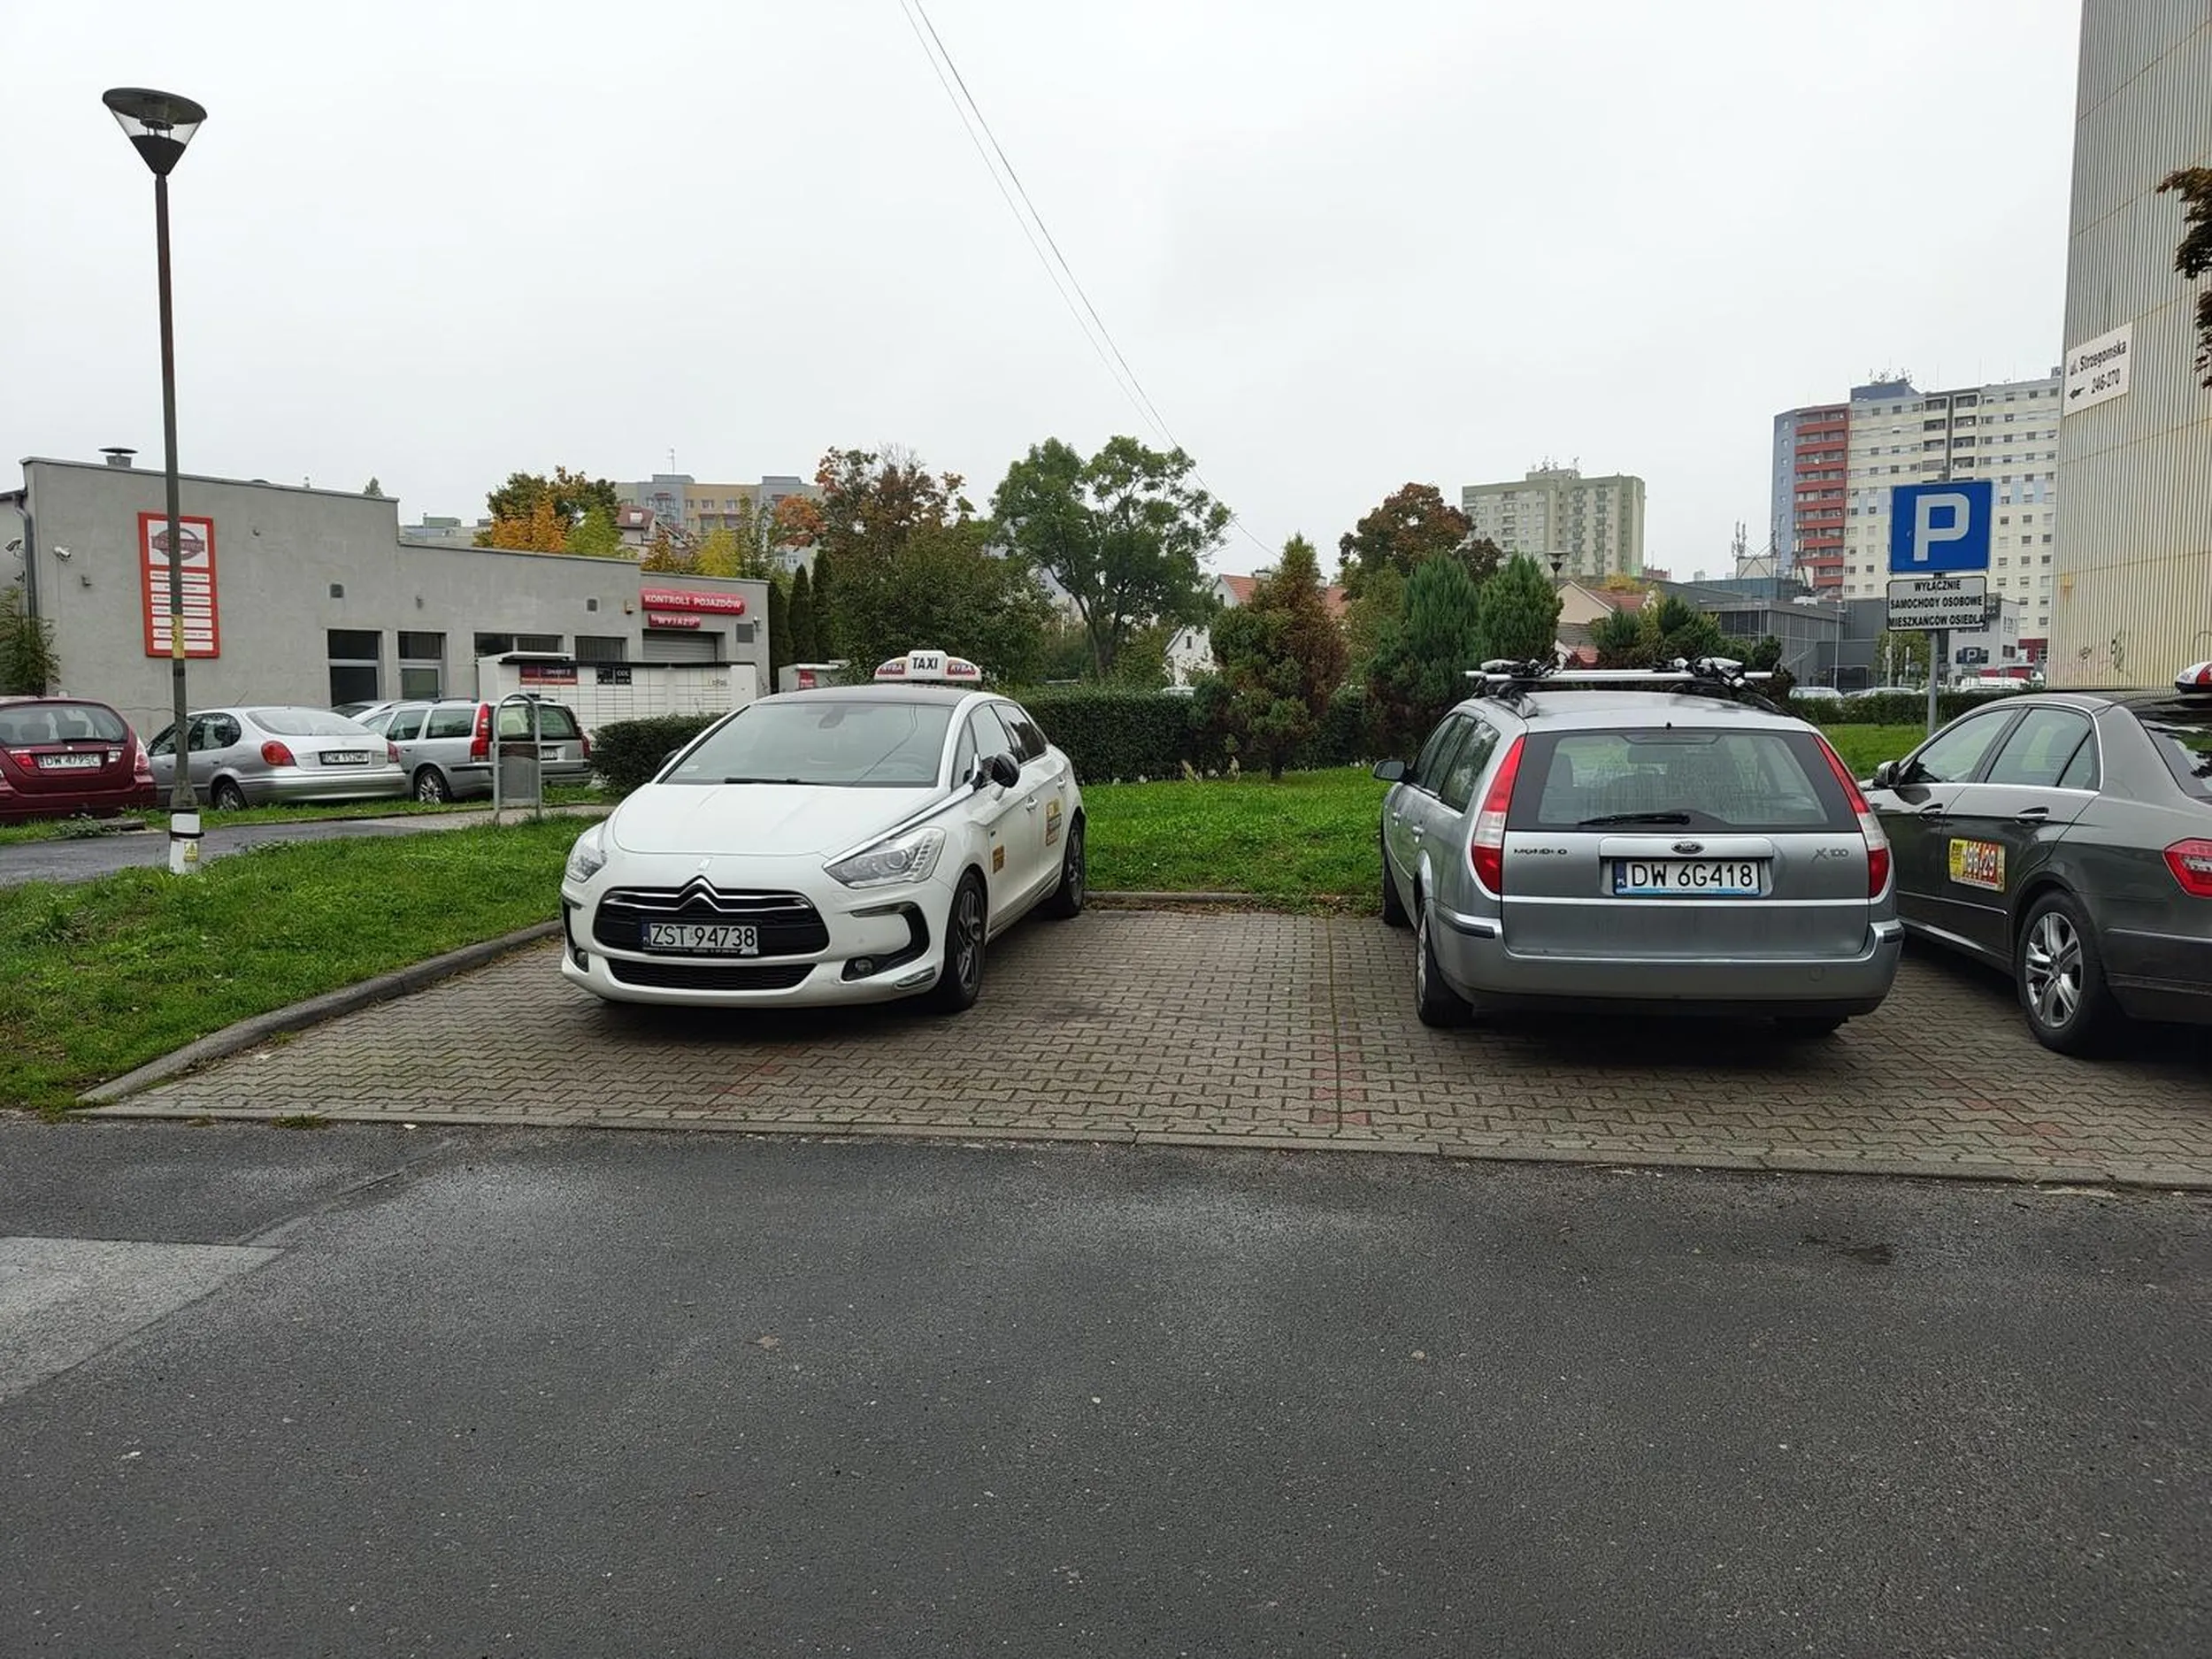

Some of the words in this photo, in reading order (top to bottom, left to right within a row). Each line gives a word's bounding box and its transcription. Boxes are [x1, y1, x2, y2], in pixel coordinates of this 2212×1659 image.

[1913, 492, 1970, 562] P
[1890, 597, 1940, 610] SAMOCHODY
[1942, 595, 1983, 607] OSOBOWE
[912, 657, 938, 670] TAXI
[1632, 864, 1668, 887] DW
[1678, 864, 1753, 887] 6G418
[651, 924, 687, 946] ZST
[694, 926, 755, 948] 94738
